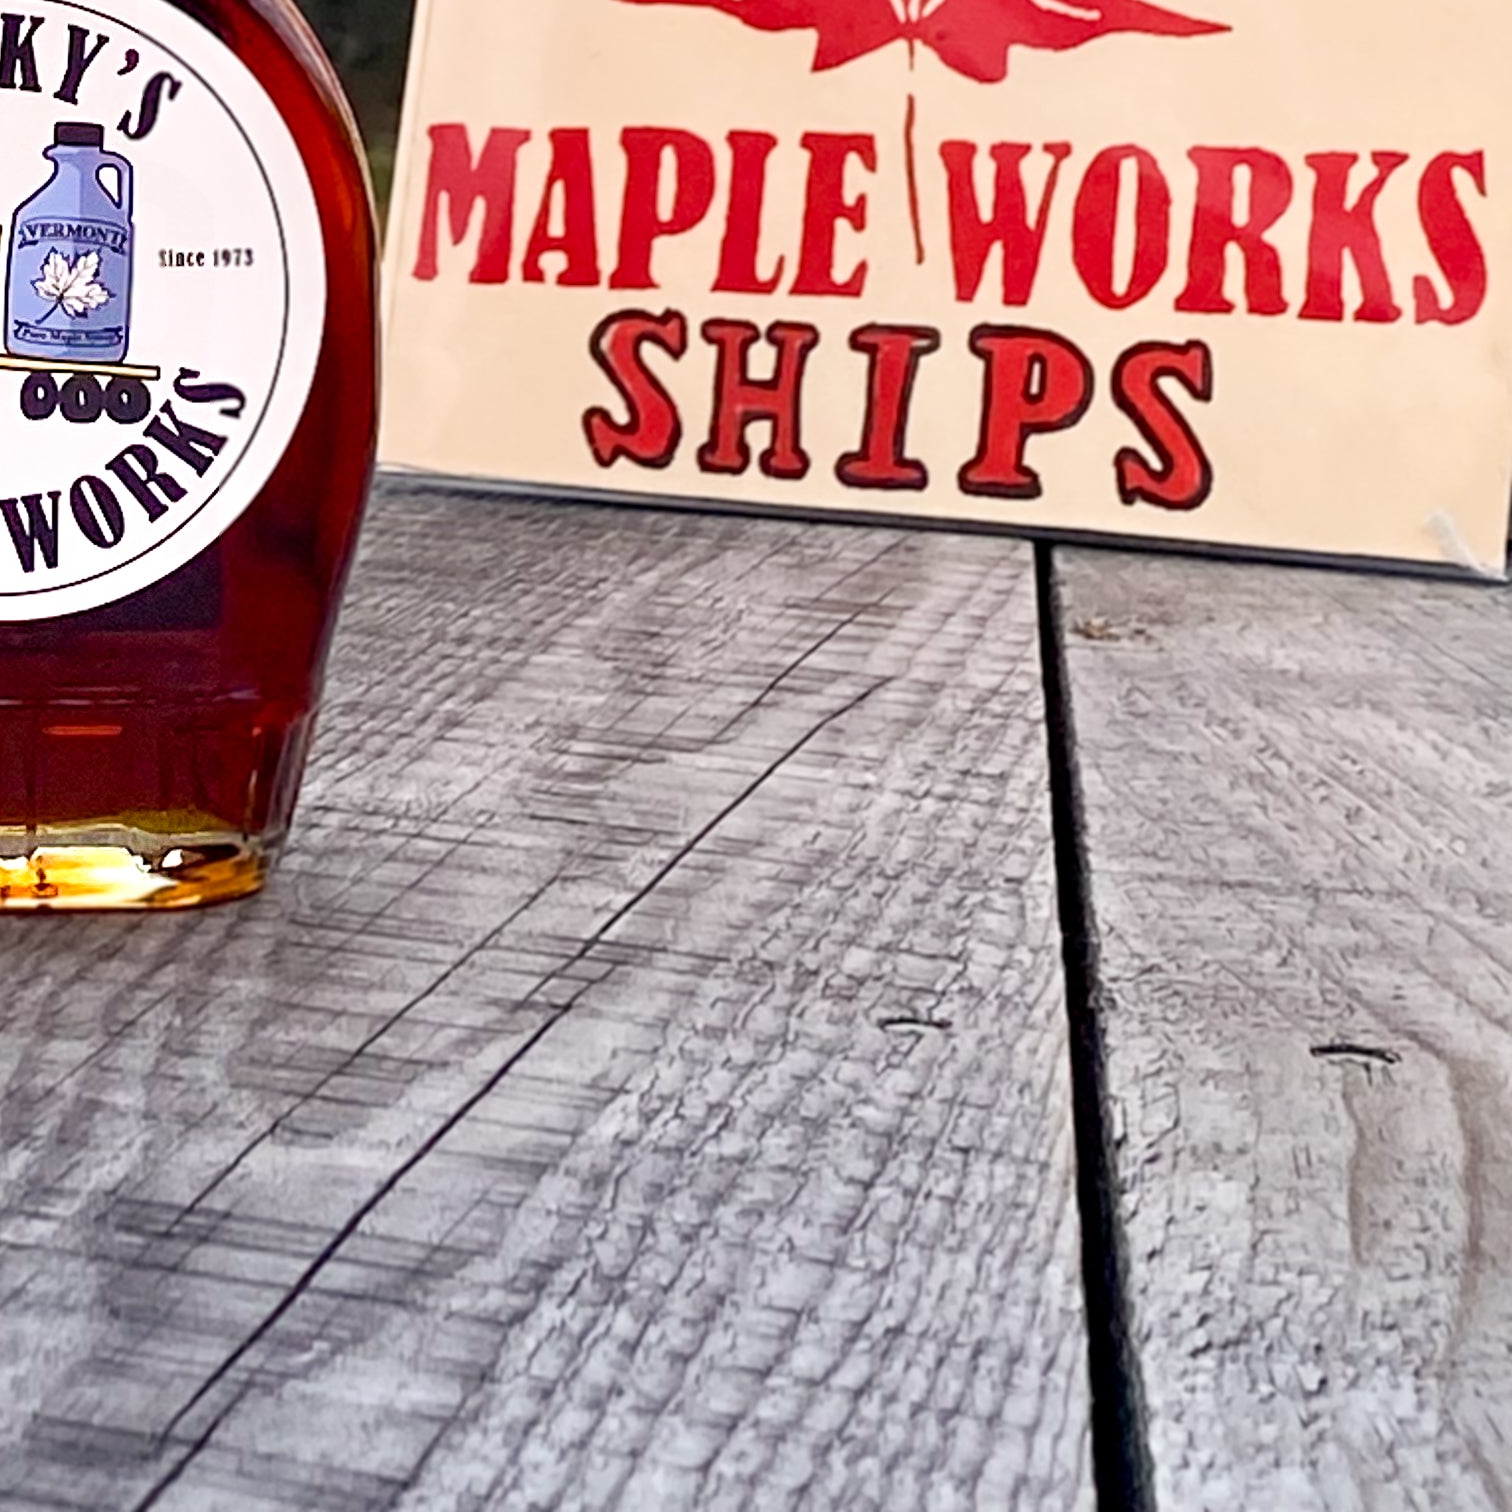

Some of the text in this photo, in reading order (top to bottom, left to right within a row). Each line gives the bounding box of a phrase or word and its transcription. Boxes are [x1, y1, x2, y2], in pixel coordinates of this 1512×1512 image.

[26, 222, 124, 245] VERMONT
[158, 248, 254, 267] Since 1973
[412, 124, 1489, 326] MAPLE WORKS
[583, 308, 1214, 511] SHIPS
